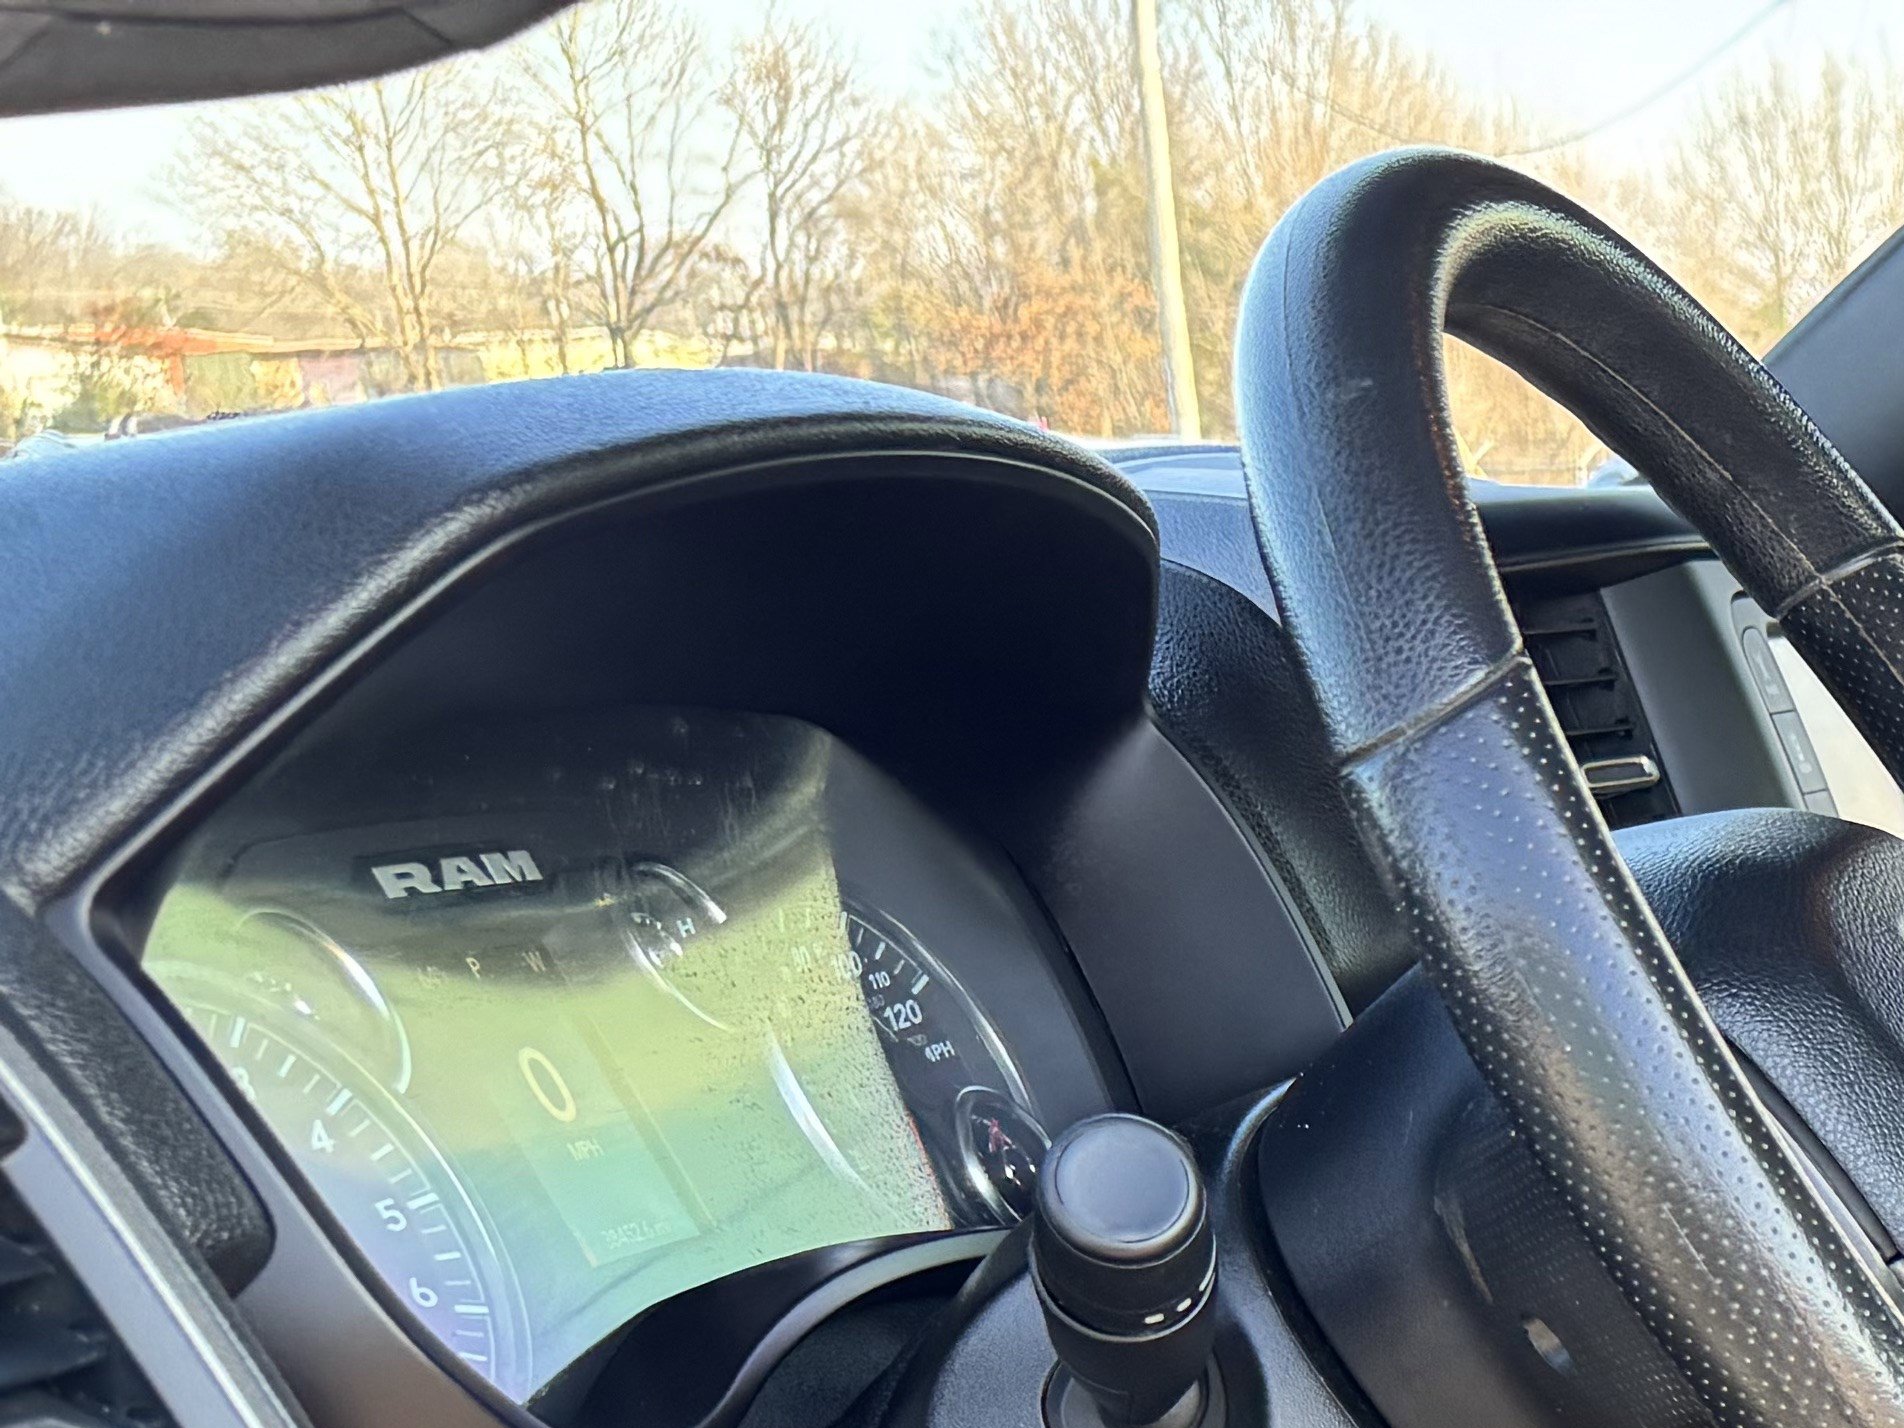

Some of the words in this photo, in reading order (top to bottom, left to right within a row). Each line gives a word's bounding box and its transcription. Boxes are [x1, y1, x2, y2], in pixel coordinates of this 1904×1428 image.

[370, 849, 543, 899] RAM
[868, 971, 890, 989] 110
[884, 999, 922, 1032] 120
[518, 1046, 576, 1122] 0
[311, 1119, 335, 1154] 4
[374, 1196, 408, 1233] 5
[408, 1276, 439, 1308] 6
